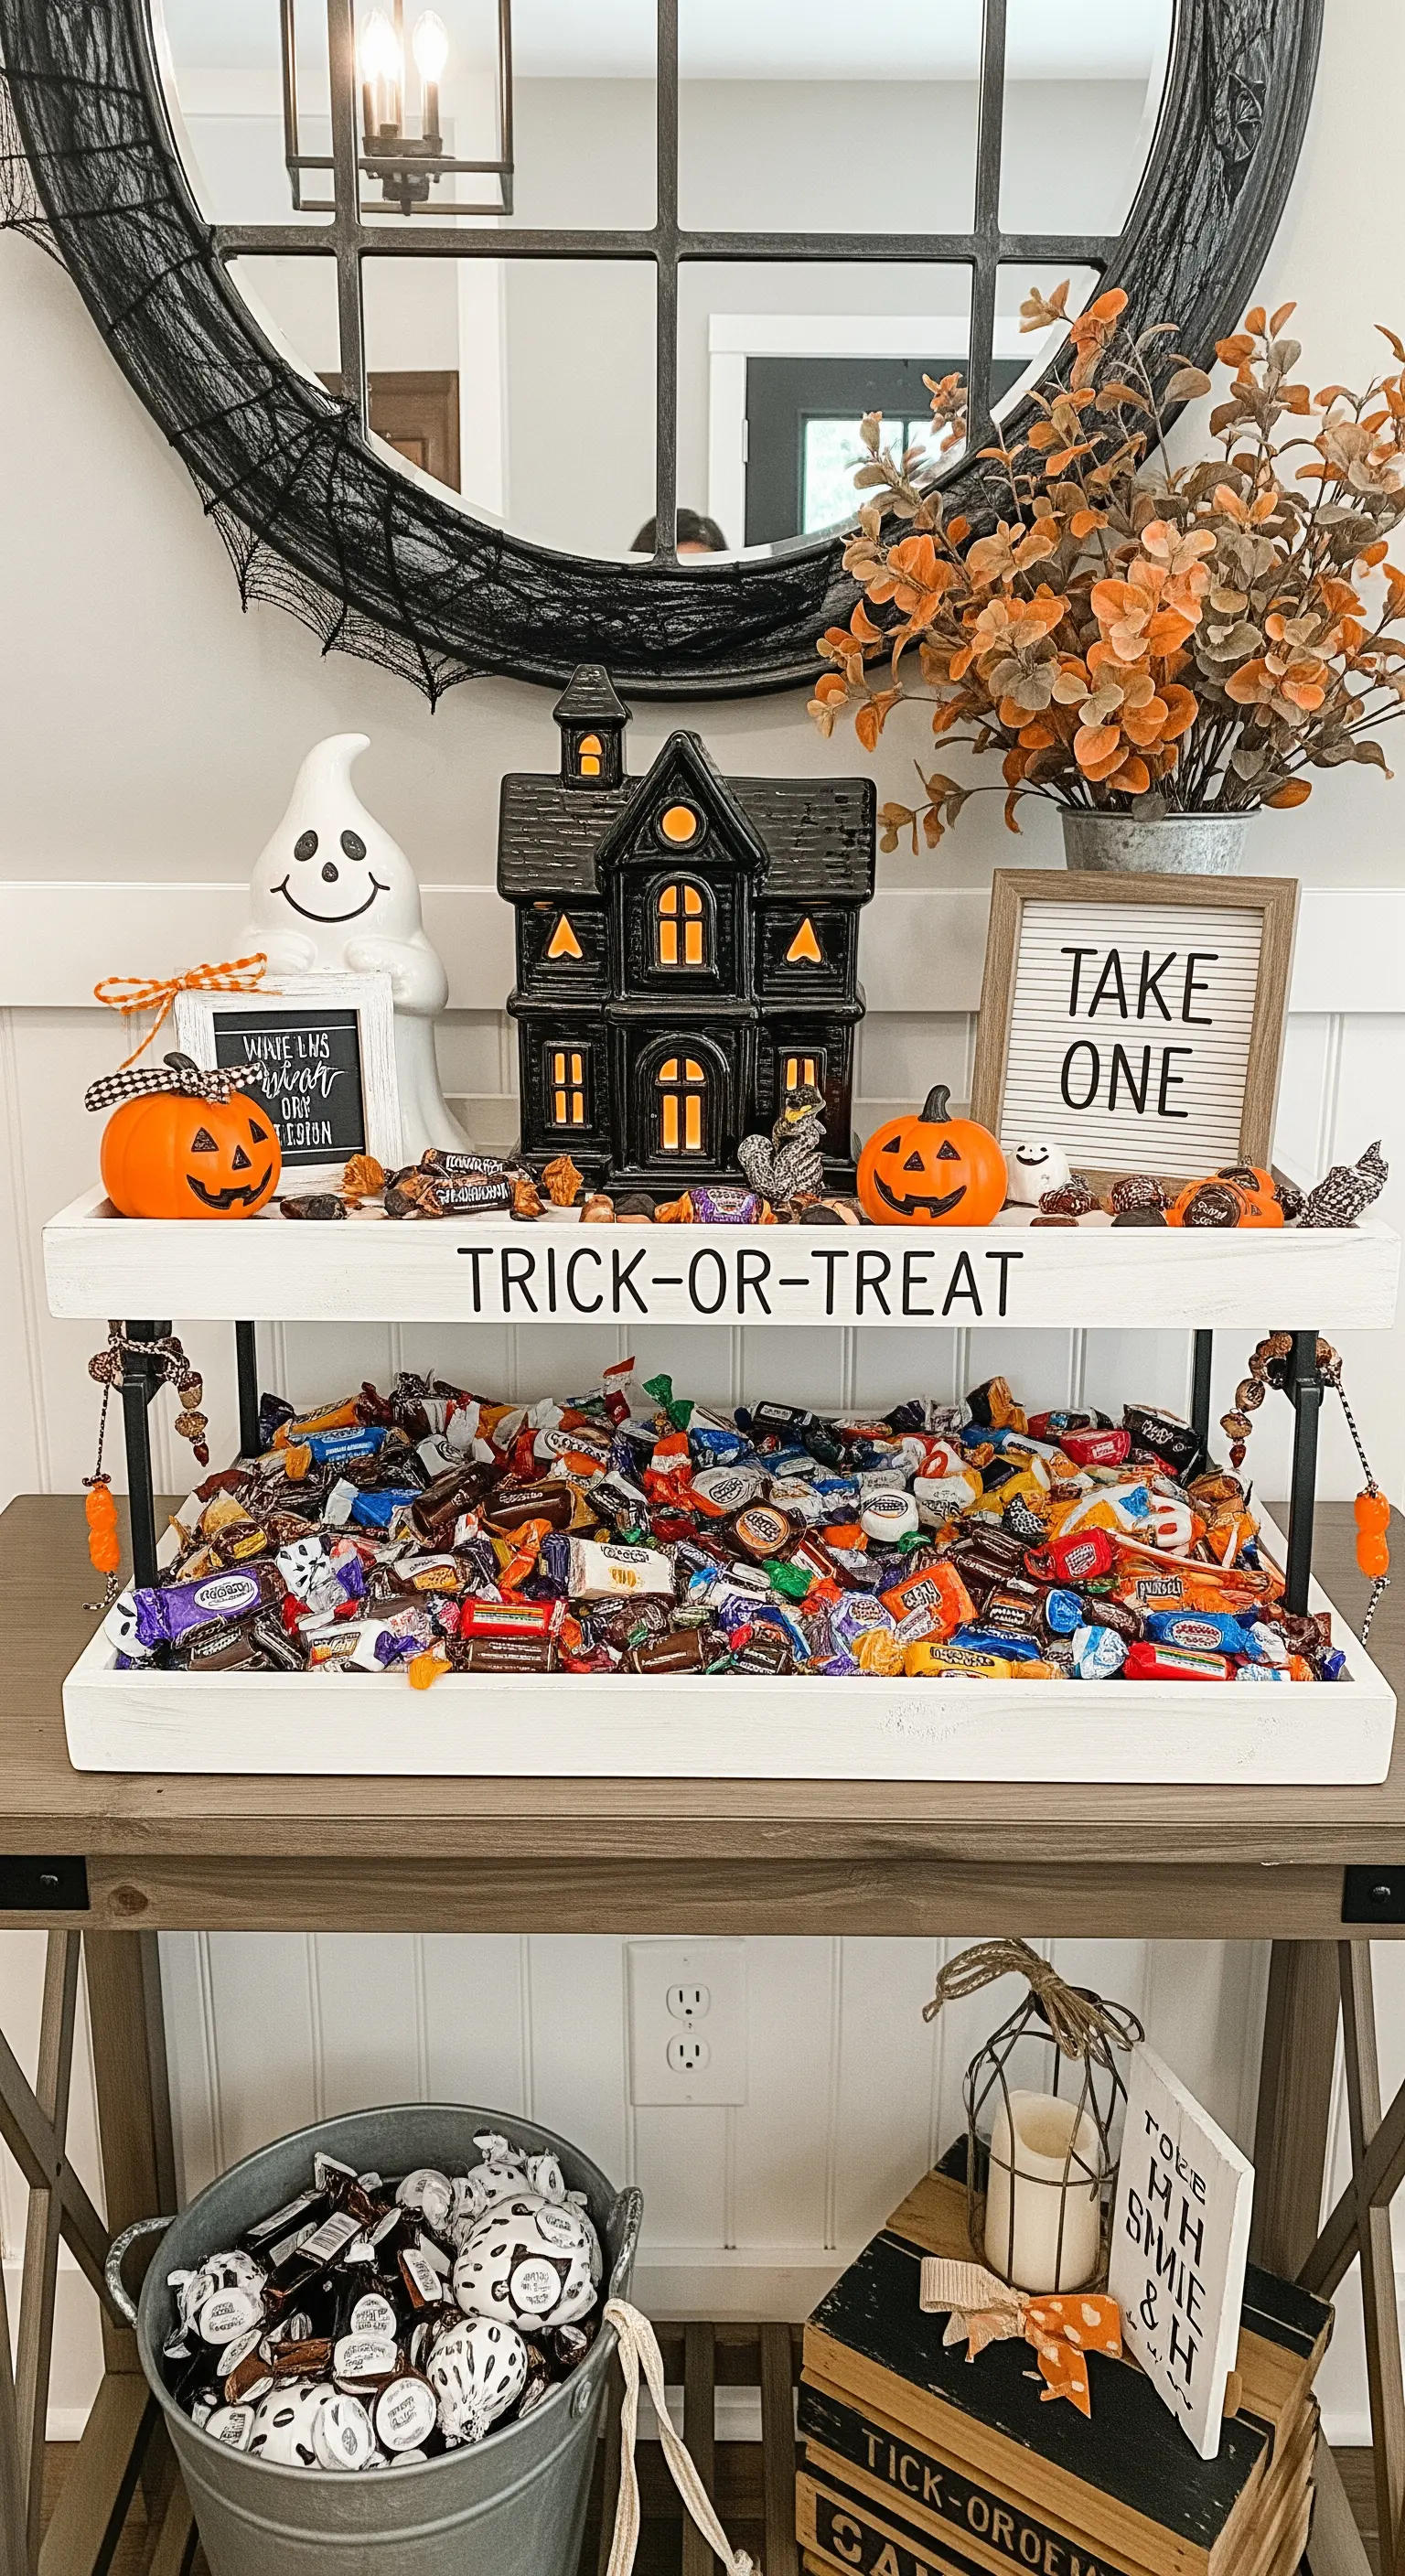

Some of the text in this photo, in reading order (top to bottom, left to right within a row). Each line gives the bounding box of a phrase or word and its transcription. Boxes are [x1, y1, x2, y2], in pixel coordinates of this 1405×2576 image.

[1061, 947, 1219, 1025] TAKE
[1061, 1040, 1193, 1118] ONE
[457, 1247, 1024, 1317] TRICK-OR-TREAT
